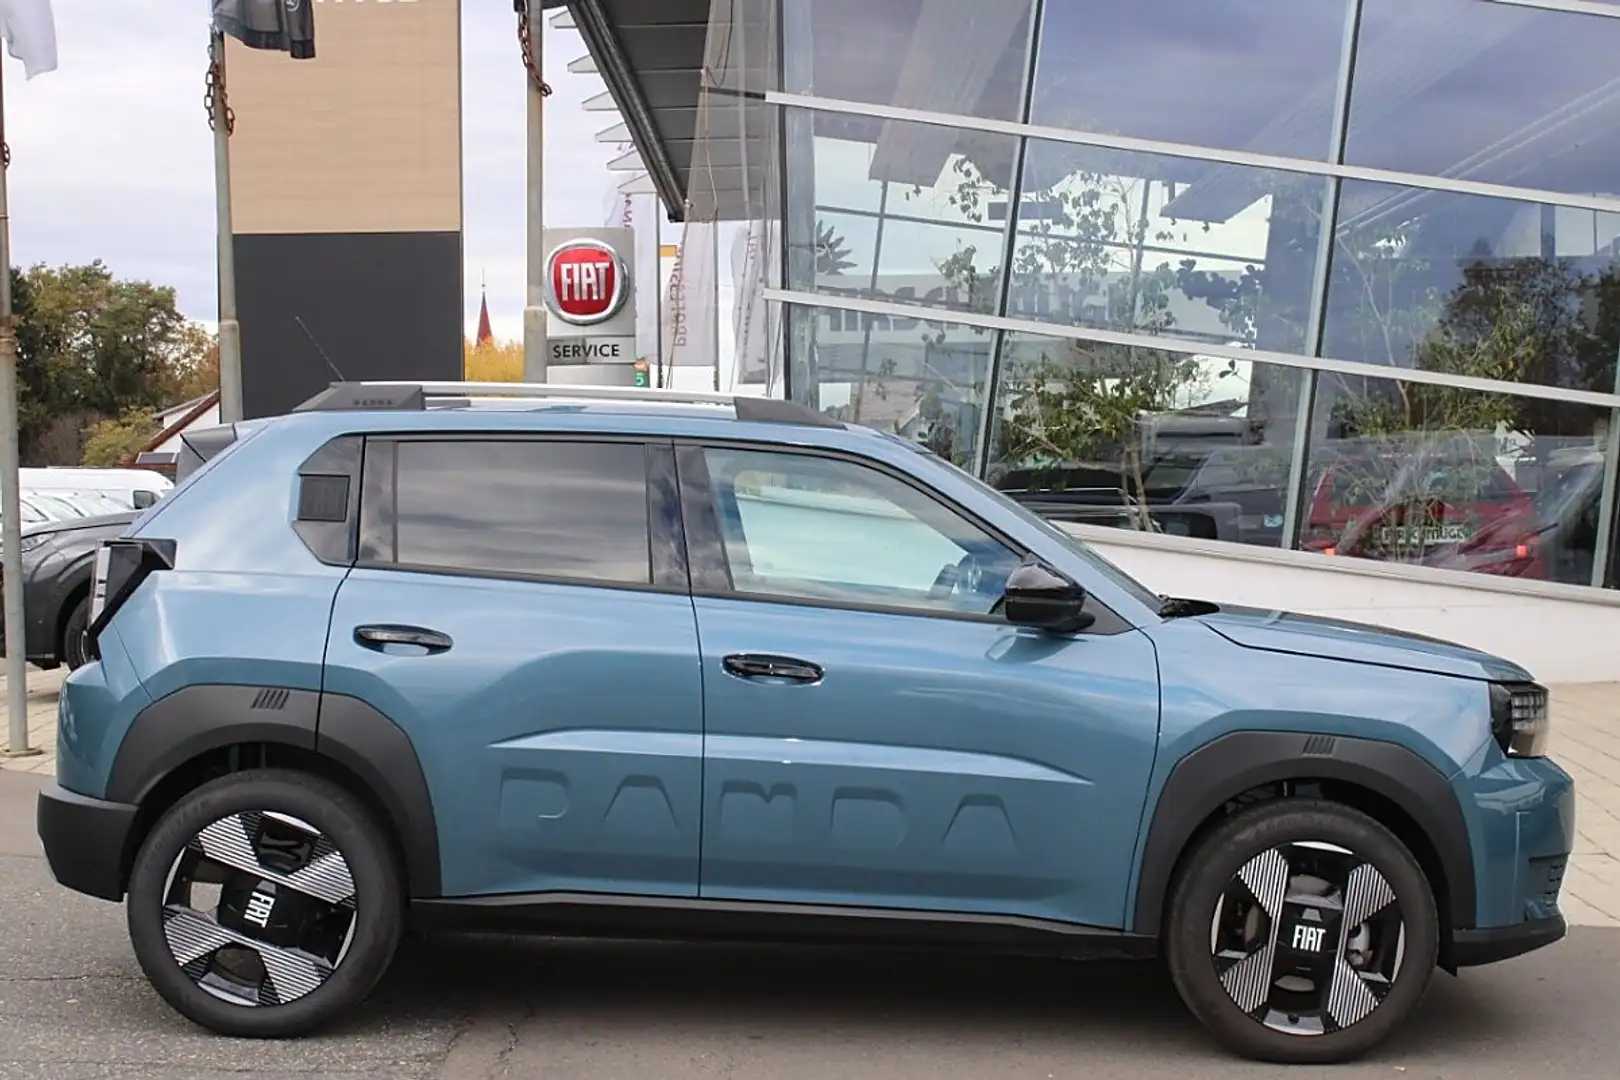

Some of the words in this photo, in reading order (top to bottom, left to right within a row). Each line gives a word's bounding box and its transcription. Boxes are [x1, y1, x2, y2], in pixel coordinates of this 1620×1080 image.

[560, 262, 610, 301] FIAT
[553, 343, 620, 358] SERVICE
[243, 891, 276, 928] FIAT
[1292, 924, 1327, 952] FIAT
